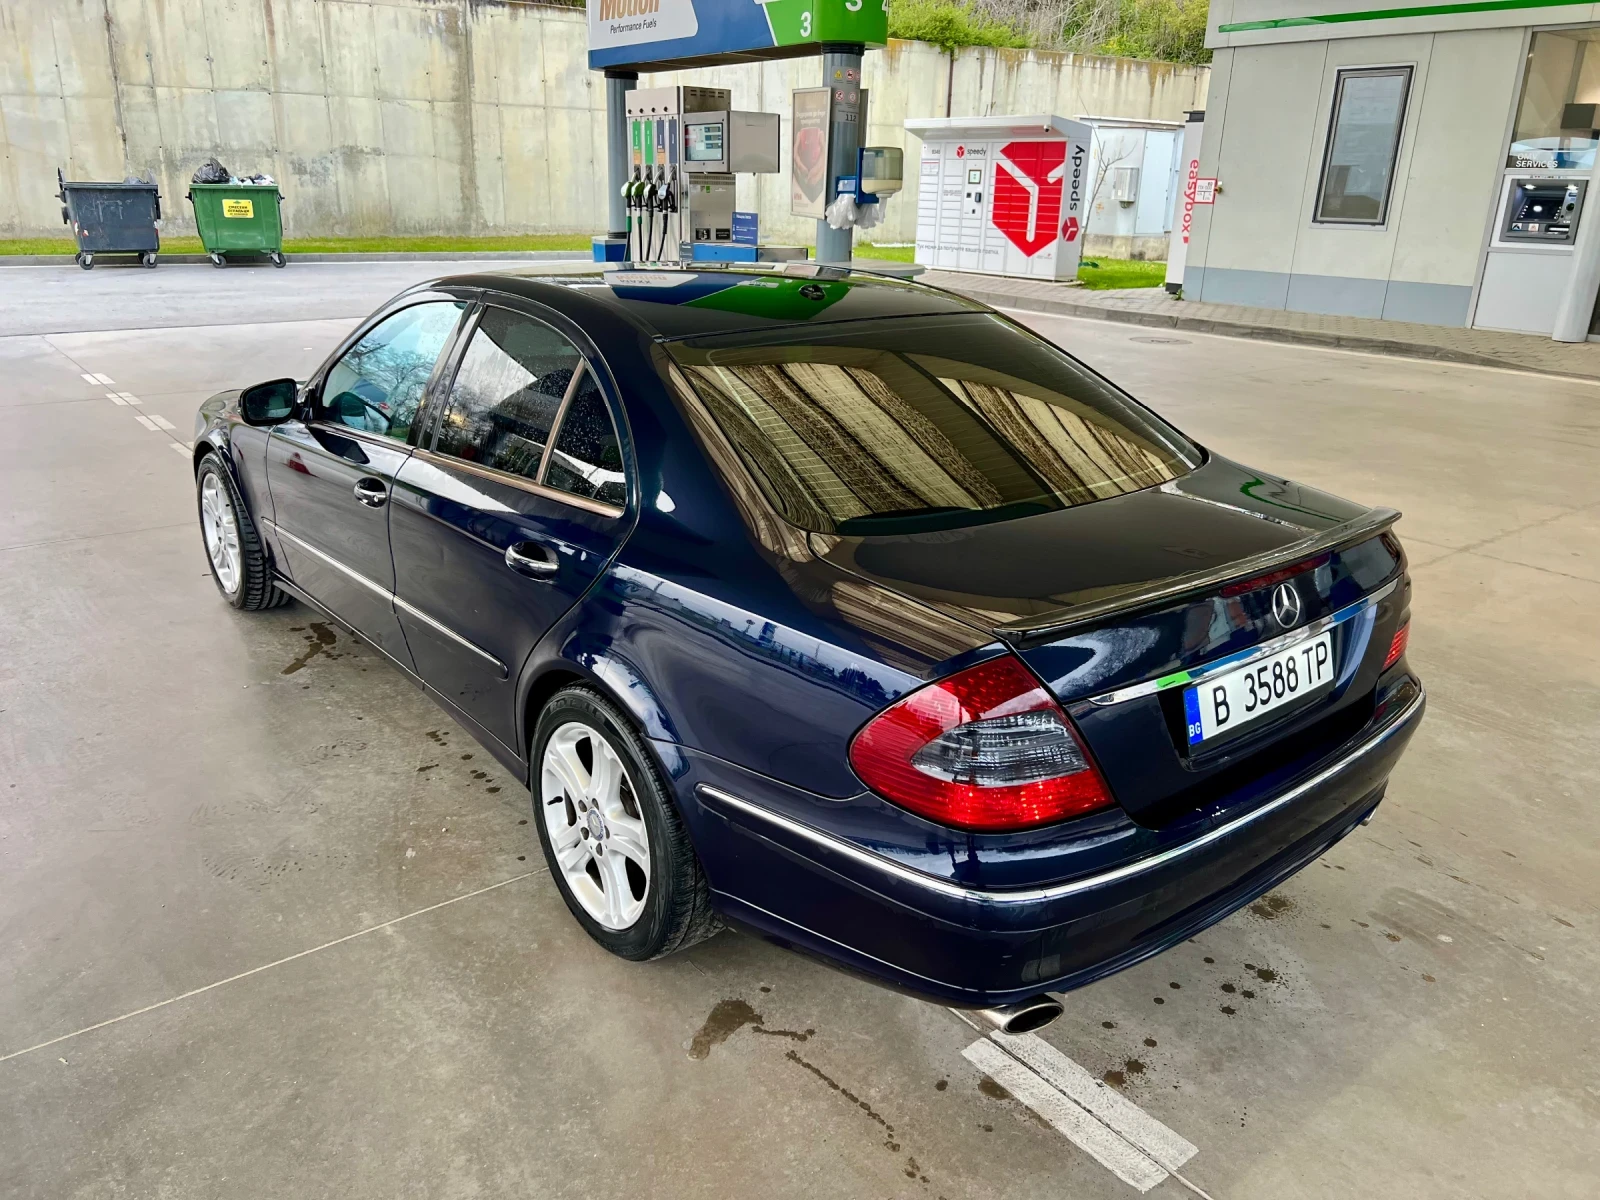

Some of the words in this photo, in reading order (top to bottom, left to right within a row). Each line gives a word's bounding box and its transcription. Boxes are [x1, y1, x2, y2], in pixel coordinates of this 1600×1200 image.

[610, 22, 642, 34] Performance
[642, 18, 657, 30] Fuels
[800, 11, 812, 38] 3
[845, 113, 857, 122] 112
[967, 147, 987, 156] speedy
[1515, 160, 1559, 168] SERVICES
[1069, 144, 1086, 211] speedy
[1182, 159, 1199, 233] easybox
[1213, 685, 1231, 727] B
[1244, 655, 1299, 713] 3588
[1302, 641, 1328, 685] TP
[1188, 722, 1202, 737] BG
